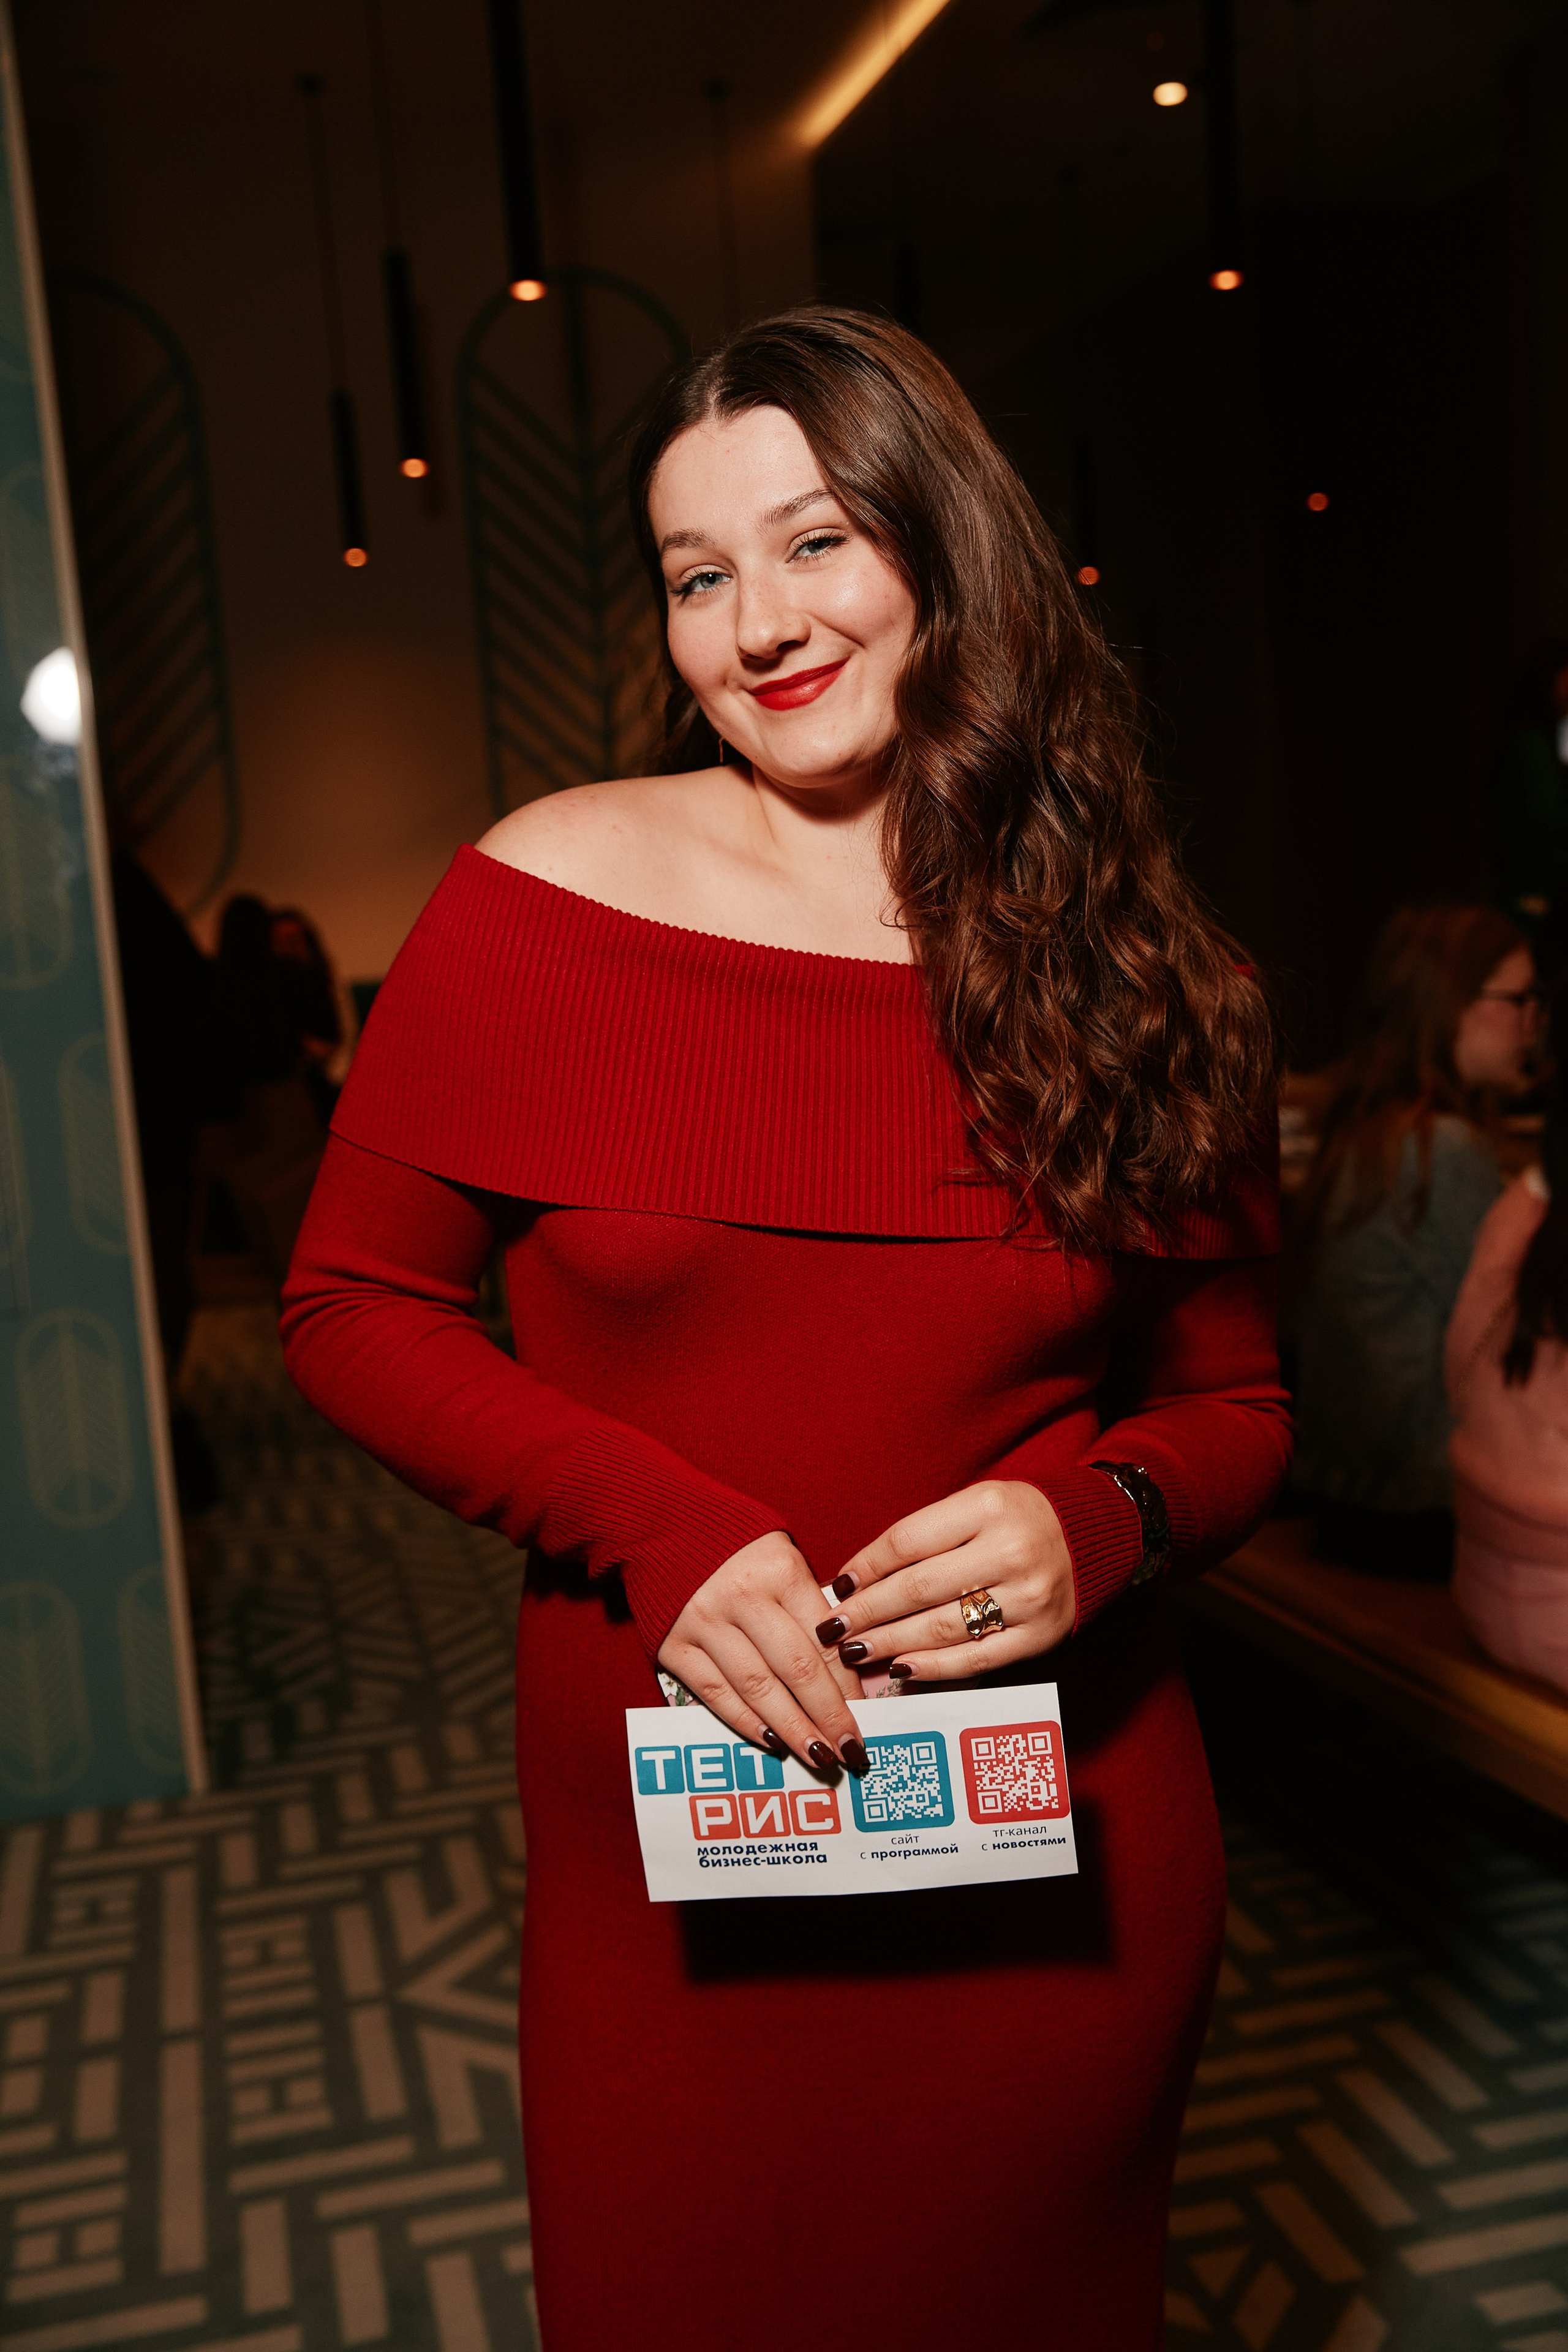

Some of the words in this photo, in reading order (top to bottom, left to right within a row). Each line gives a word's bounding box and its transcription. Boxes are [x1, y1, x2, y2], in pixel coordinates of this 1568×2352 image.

[641, 1746, 766, 1790] ТЕТ
[695, 1793, 834, 1836] РИС
[992, 1826, 1047, 1838] тг-канал
[891, 1834, 919, 1845] сайт
[992, 1837, 1066, 1850] новостями
[697, 1842, 818, 1856] молодежная
[860, 1851, 866, 1860] с
[871, 1844, 959, 1861] программой
[699, 1854, 827, 1868] бизнес-школа
